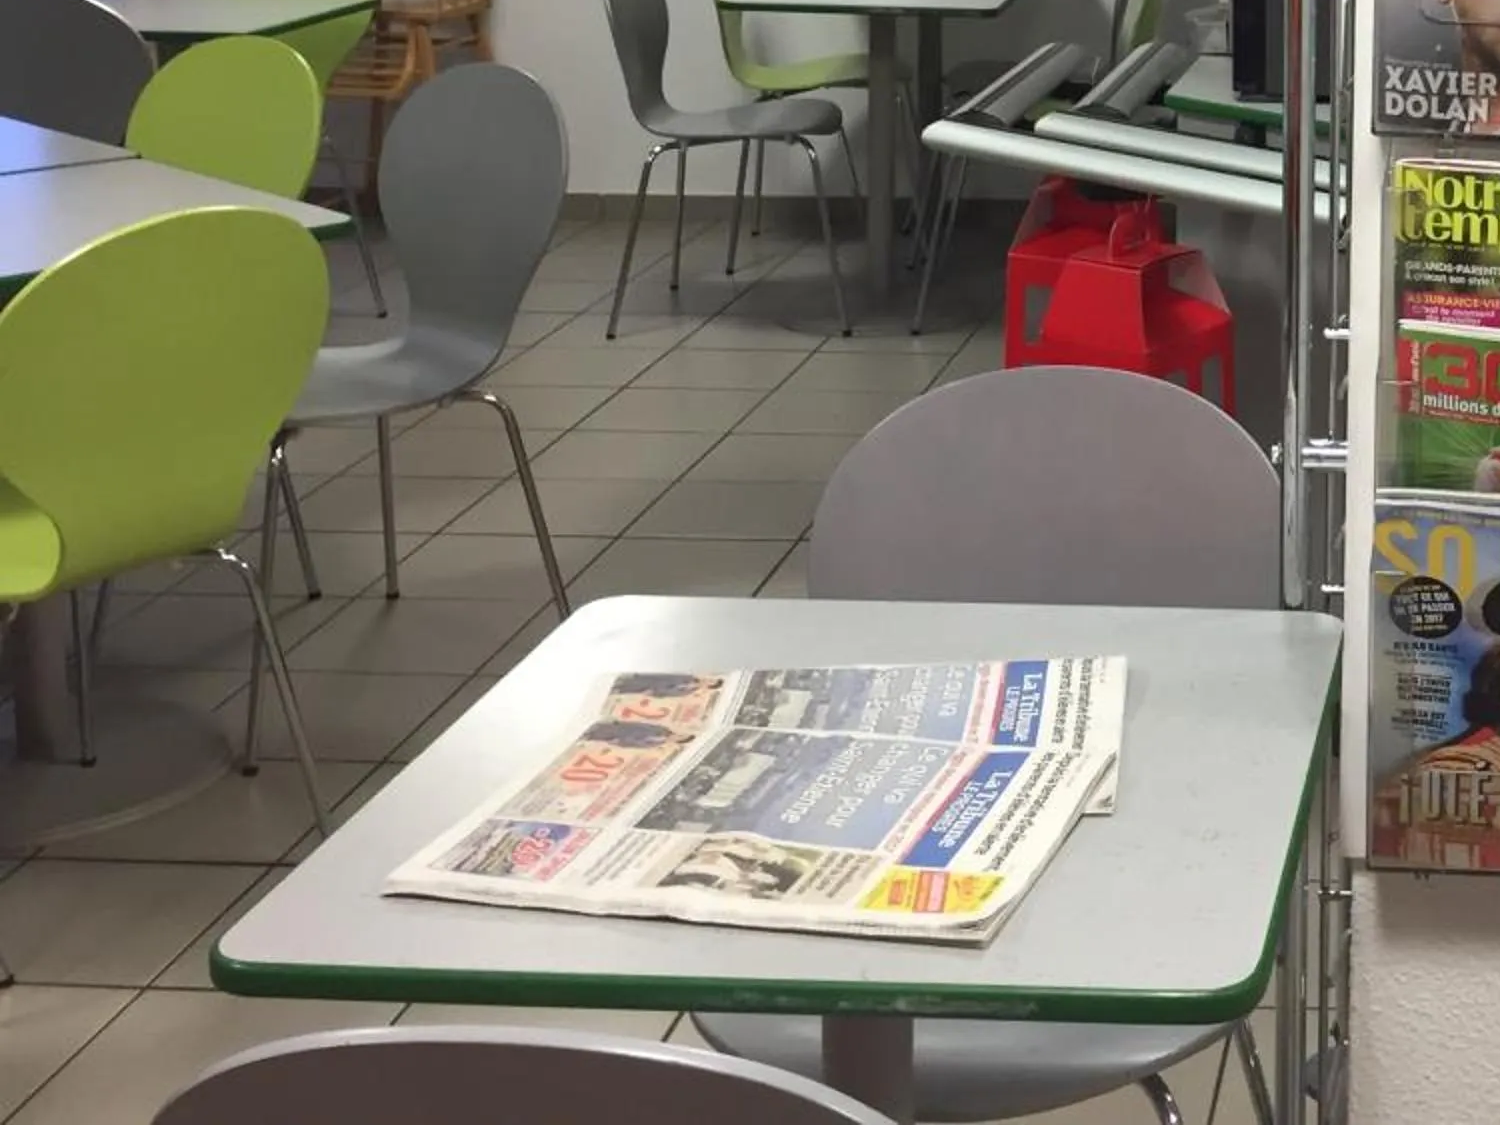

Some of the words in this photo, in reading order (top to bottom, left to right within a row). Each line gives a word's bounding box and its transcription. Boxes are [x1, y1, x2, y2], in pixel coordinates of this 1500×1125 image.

[1385, 65, 1498, 97] XAVIER
[1385, 93, 1491, 123] DOLAN
[1423, 392, 1489, 417] millions
[1373, 518, 1477, 604] SO
[1023, 672, 1042, 691] La
[917, 745, 949, 763] Ce
[855, 742, 911, 796] changer
[900, 763, 928, 789] qui
[984, 770, 1012, 789] La
[884, 783, 909, 805] va
[826, 793, 864, 827] pour
[938, 784, 1003, 849] Tribune
